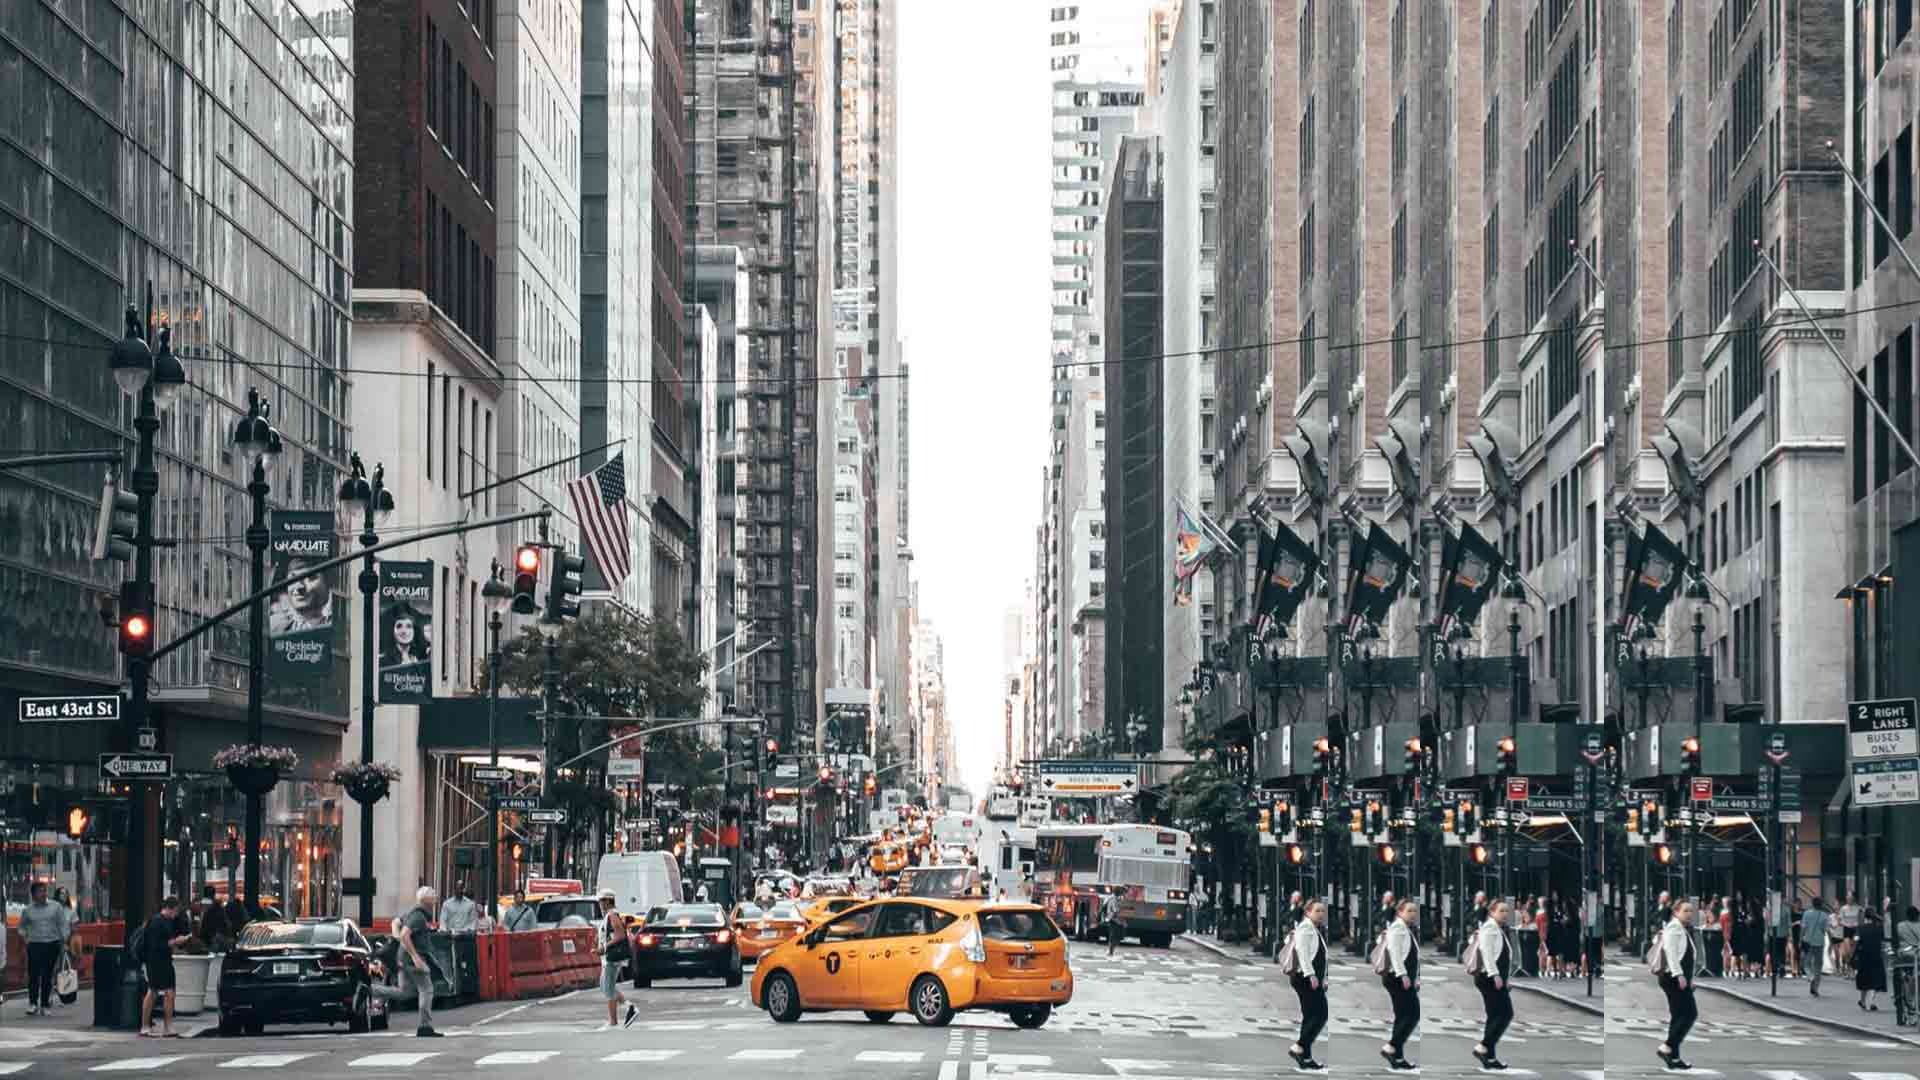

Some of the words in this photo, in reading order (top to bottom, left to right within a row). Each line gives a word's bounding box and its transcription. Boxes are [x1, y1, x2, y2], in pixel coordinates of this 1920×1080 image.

[274, 540, 329, 551] GRADUATE
[382, 586, 430, 598] GRADUATE
[285, 639, 325, 652] Berkeley
[287, 652, 322, 663] College
[392, 673, 426, 685] Berkeley
[394, 683, 424, 693] College
[26, 703, 57, 717] East
[61, 702, 93, 717] 43rd
[97, 702, 113, 716] St
[1858, 705, 1868, 719] 2
[1874, 707, 1906, 718] RIGHT
[1872, 719, 1909, 730] LANES
[1867, 733, 1900, 743] BUSES
[1871, 744, 1898, 754] ONLY
[112, 761, 136, 772] ONE
[140, 760, 161, 771] WAY
